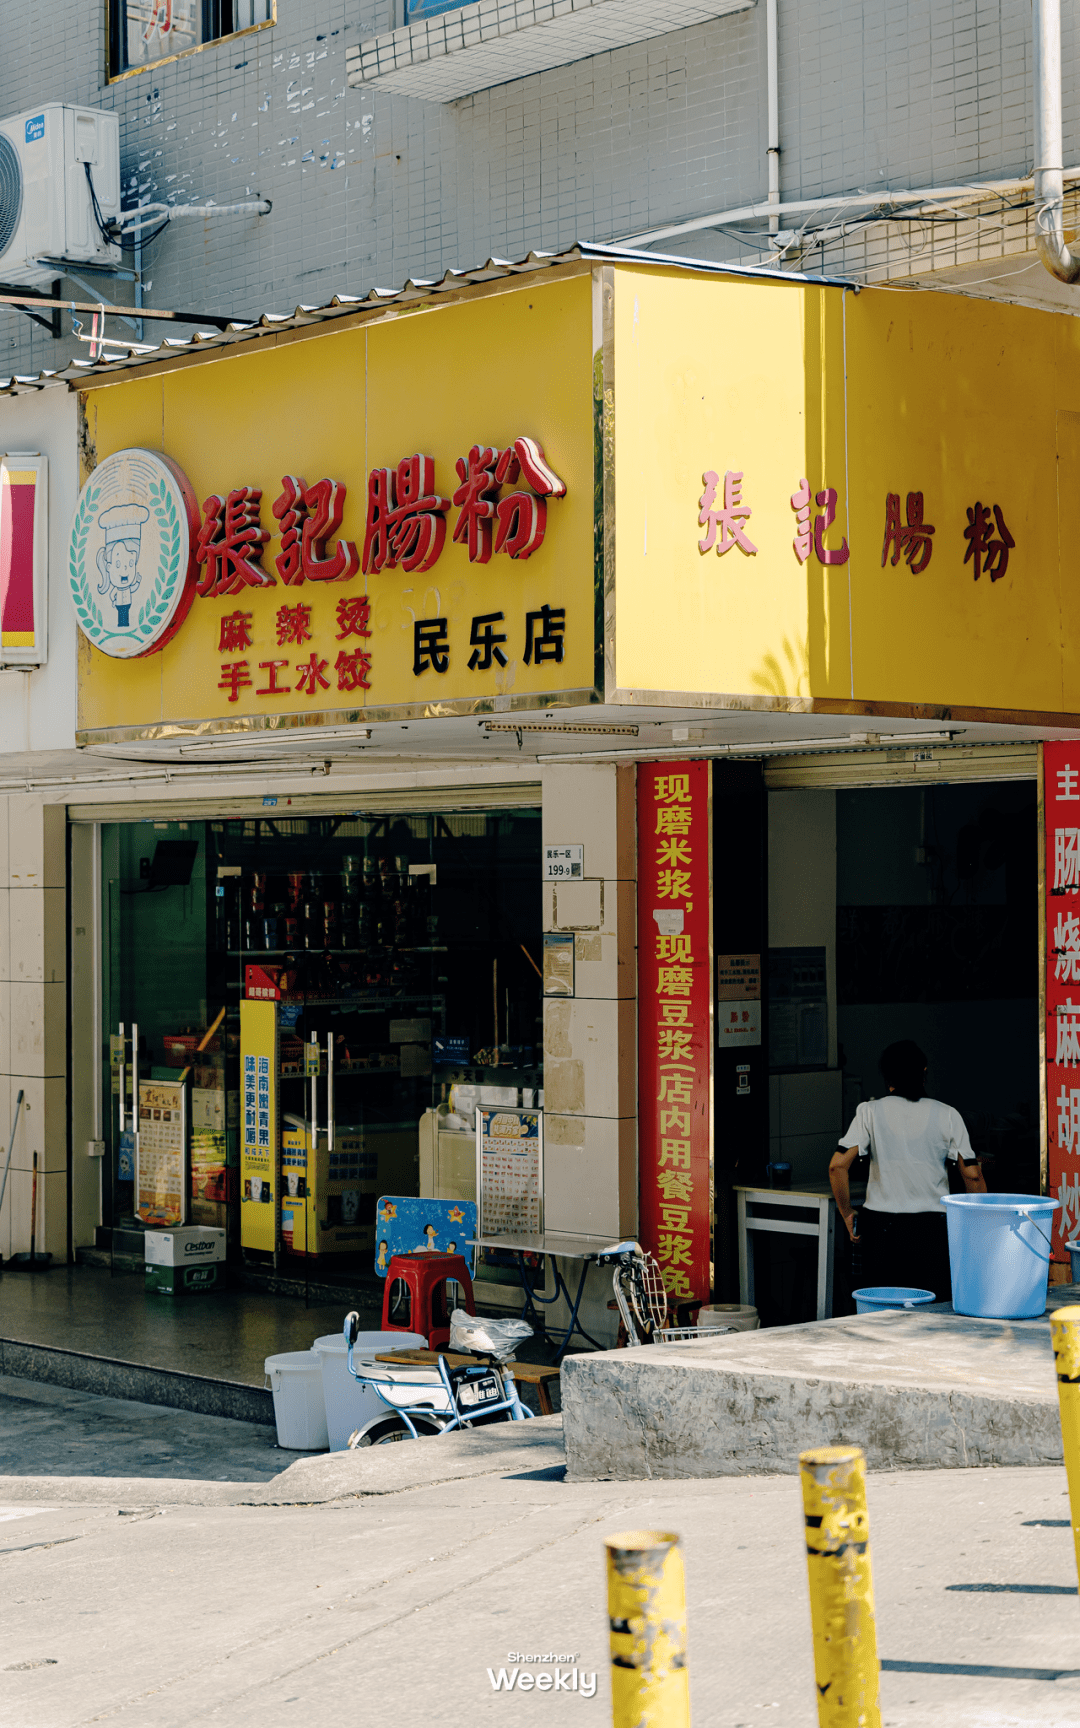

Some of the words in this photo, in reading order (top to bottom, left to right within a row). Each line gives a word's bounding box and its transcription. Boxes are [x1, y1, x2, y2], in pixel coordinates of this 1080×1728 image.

[196, 437, 567, 598] 張記腸粉
[698, 470, 1015, 582] 張記腸粉
[217, 596, 373, 653] 麻辣烫
[412, 605, 567, 676] 民乐店
[217, 648, 373, 703] 手工水饺
[547, 850, 571, 859] 民乐一区
